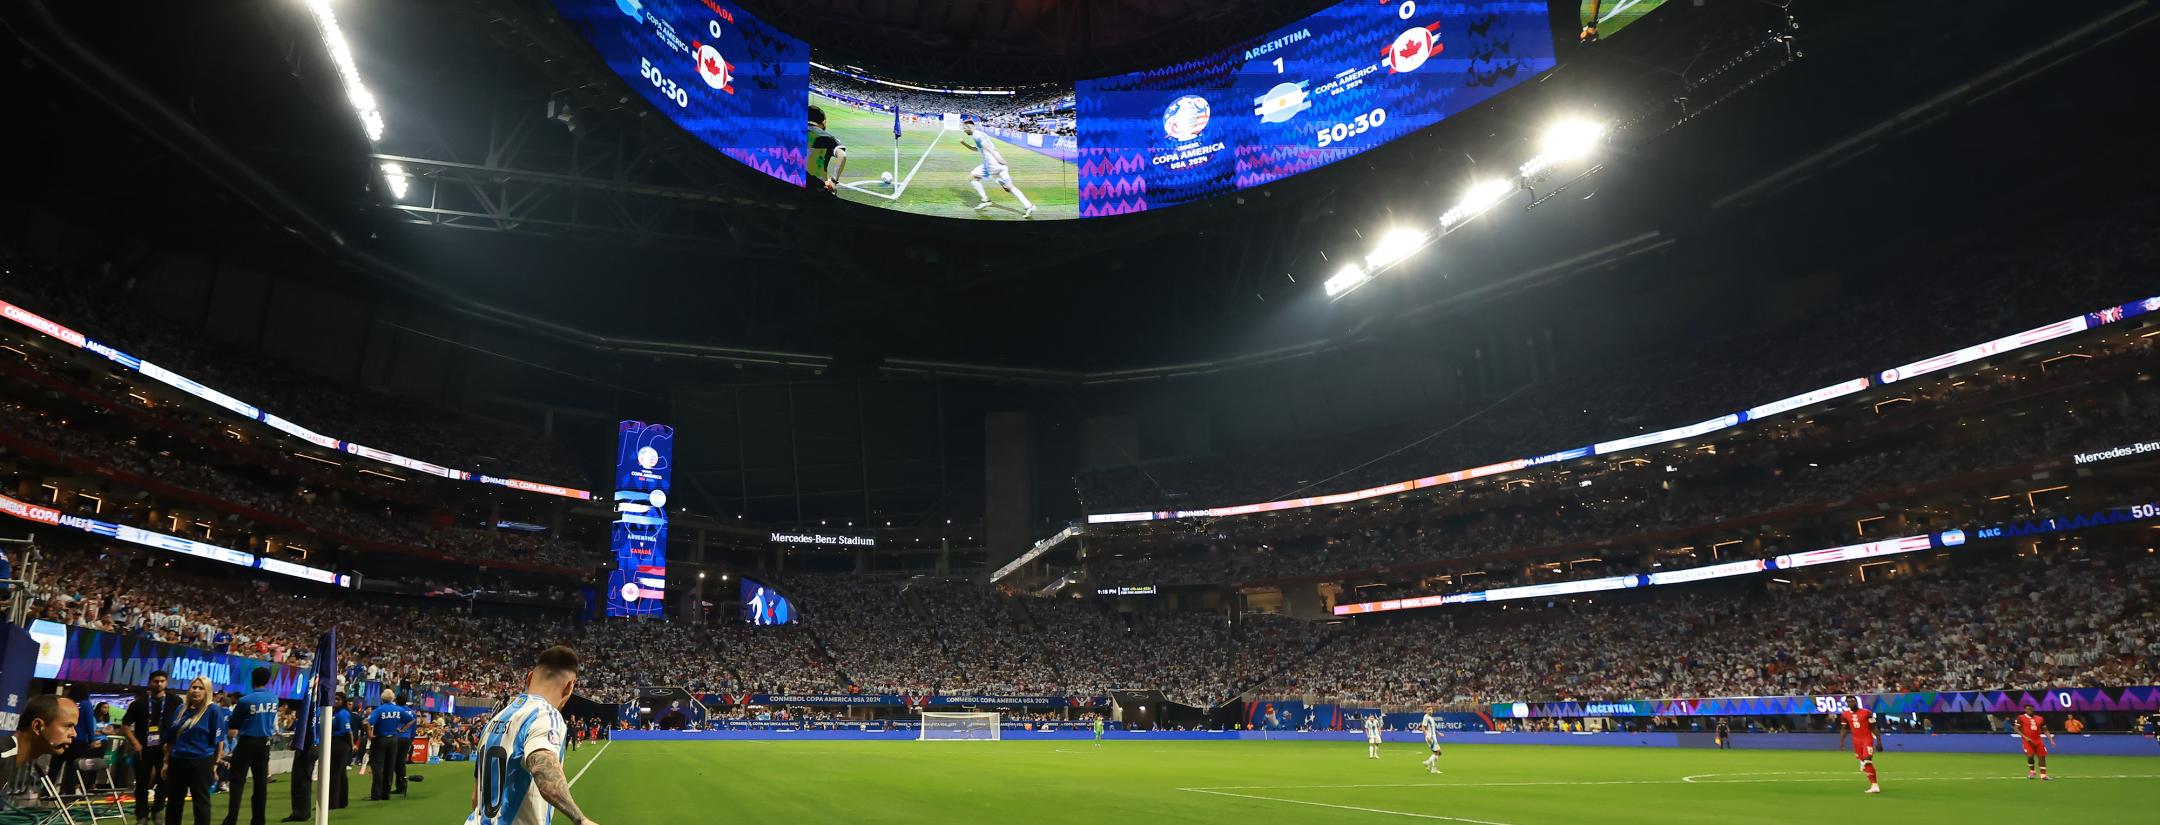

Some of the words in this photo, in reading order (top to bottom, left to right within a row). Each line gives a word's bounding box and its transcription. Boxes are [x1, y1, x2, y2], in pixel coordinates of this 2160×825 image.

[1399, 0, 1416, 20] 0
[646, 12, 662, 30] COPA
[663, 28, 689, 53] AMERICA
[709, 20, 721, 38] 0
[1245, 28, 1311, 60] ARGENTINA
[1273, 57, 1284, 74] 1
[641, 57, 688, 108] 50:30
[1315, 82, 1339, 95] COPA
[1339, 64, 1378, 86] AMERICA
[1331, 87, 1345, 96] USA
[1317, 108, 1386, 148] 50:30
[1152, 153, 1179, 165] COPA
[1180, 142, 1225, 160] AMERICA
[1170, 161, 1186, 169] USA
[1189, 156, 1208, 166] 2024
[61, 329, 87, 348] COPA
[2074, 441, 2160, 465] Mercedes-Ben
[519, 482, 538, 491] COPA
[29, 508, 59, 523] COPA
[1978, 528, 2001, 538] ARG
[2049, 519, 2056, 530] 1
[771, 533, 836, 544] Mercedes-Benz
[838, 535, 875, 546] Stadium
[172, 656, 231, 686] ARGENTINA
[1586, 703, 1636, 714] ARGENTINA
[1681, 701, 1687, 712] 1
[2059, 692, 2071, 707] 0
